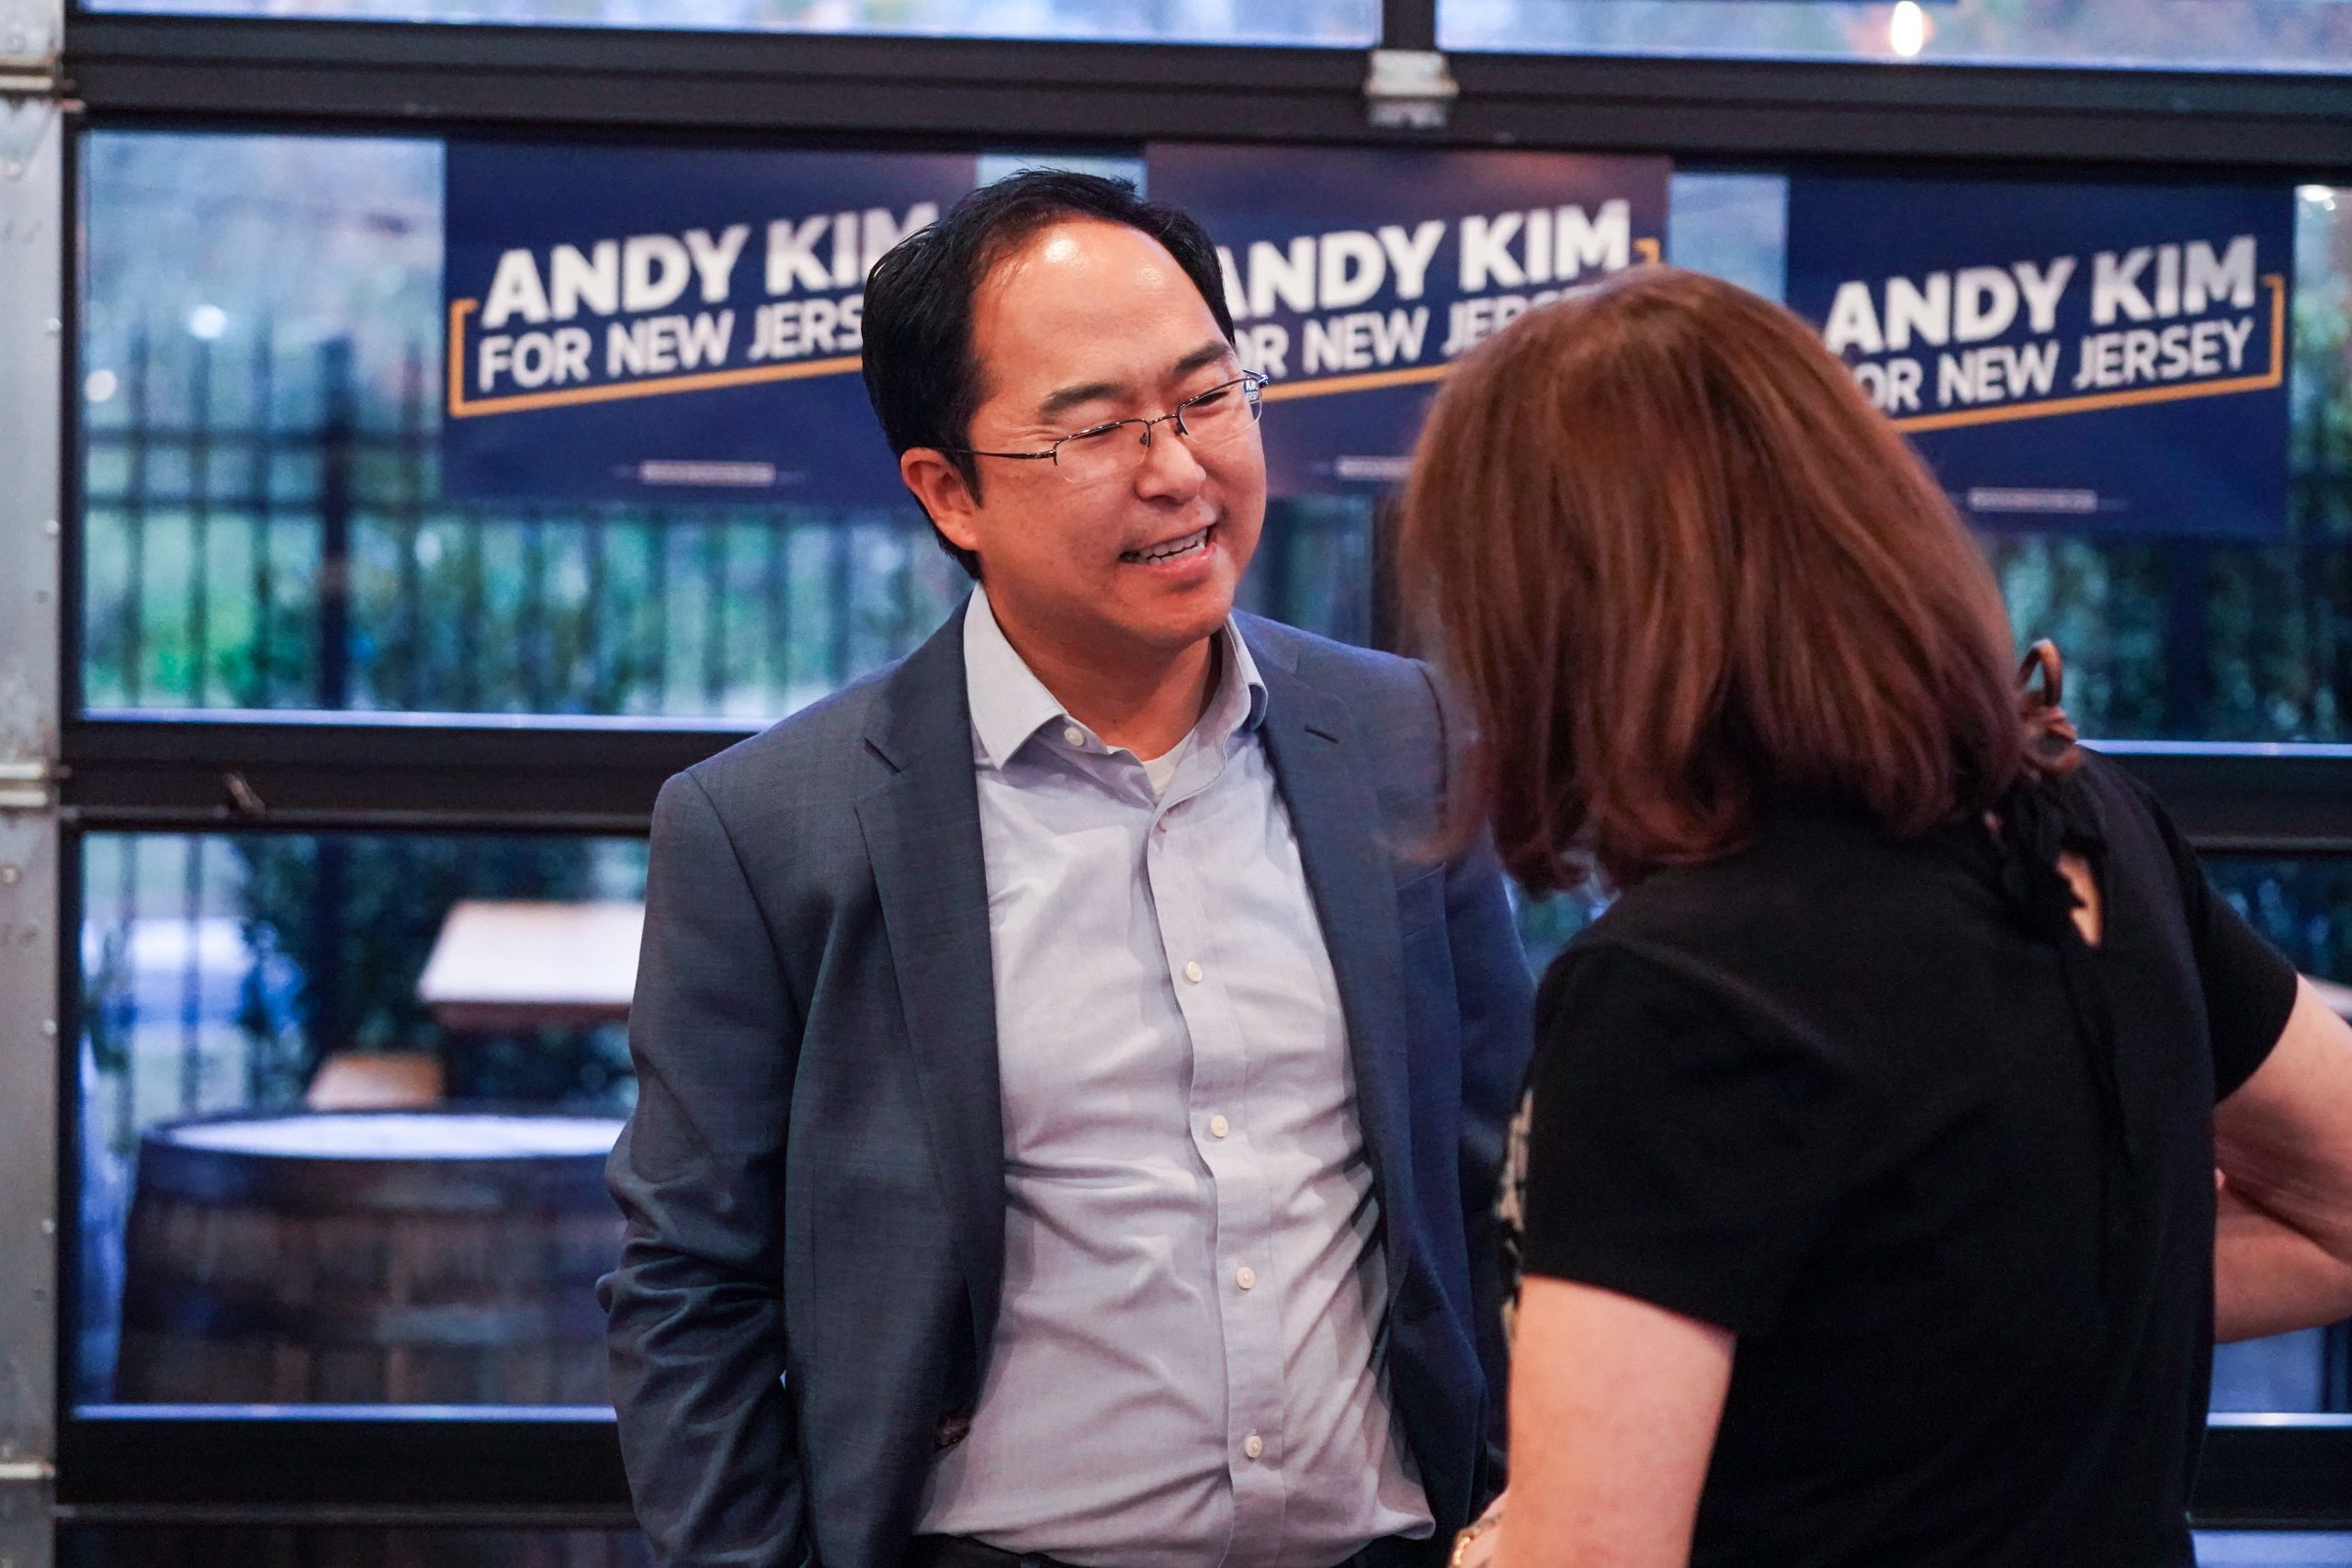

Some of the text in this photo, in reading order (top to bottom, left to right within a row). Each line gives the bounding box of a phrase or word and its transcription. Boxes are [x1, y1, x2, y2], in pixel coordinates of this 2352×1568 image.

[481, 224, 750, 329] ANDY
[1458, 198, 1632, 293] KIM
[478, 292, 864, 393] FOR NEW JERS
[1303, 307, 1429, 373] NEW
[1825, 235, 2256, 355] ANDY KIM
[1853, 318, 2254, 414] OR NEW JERSEY
